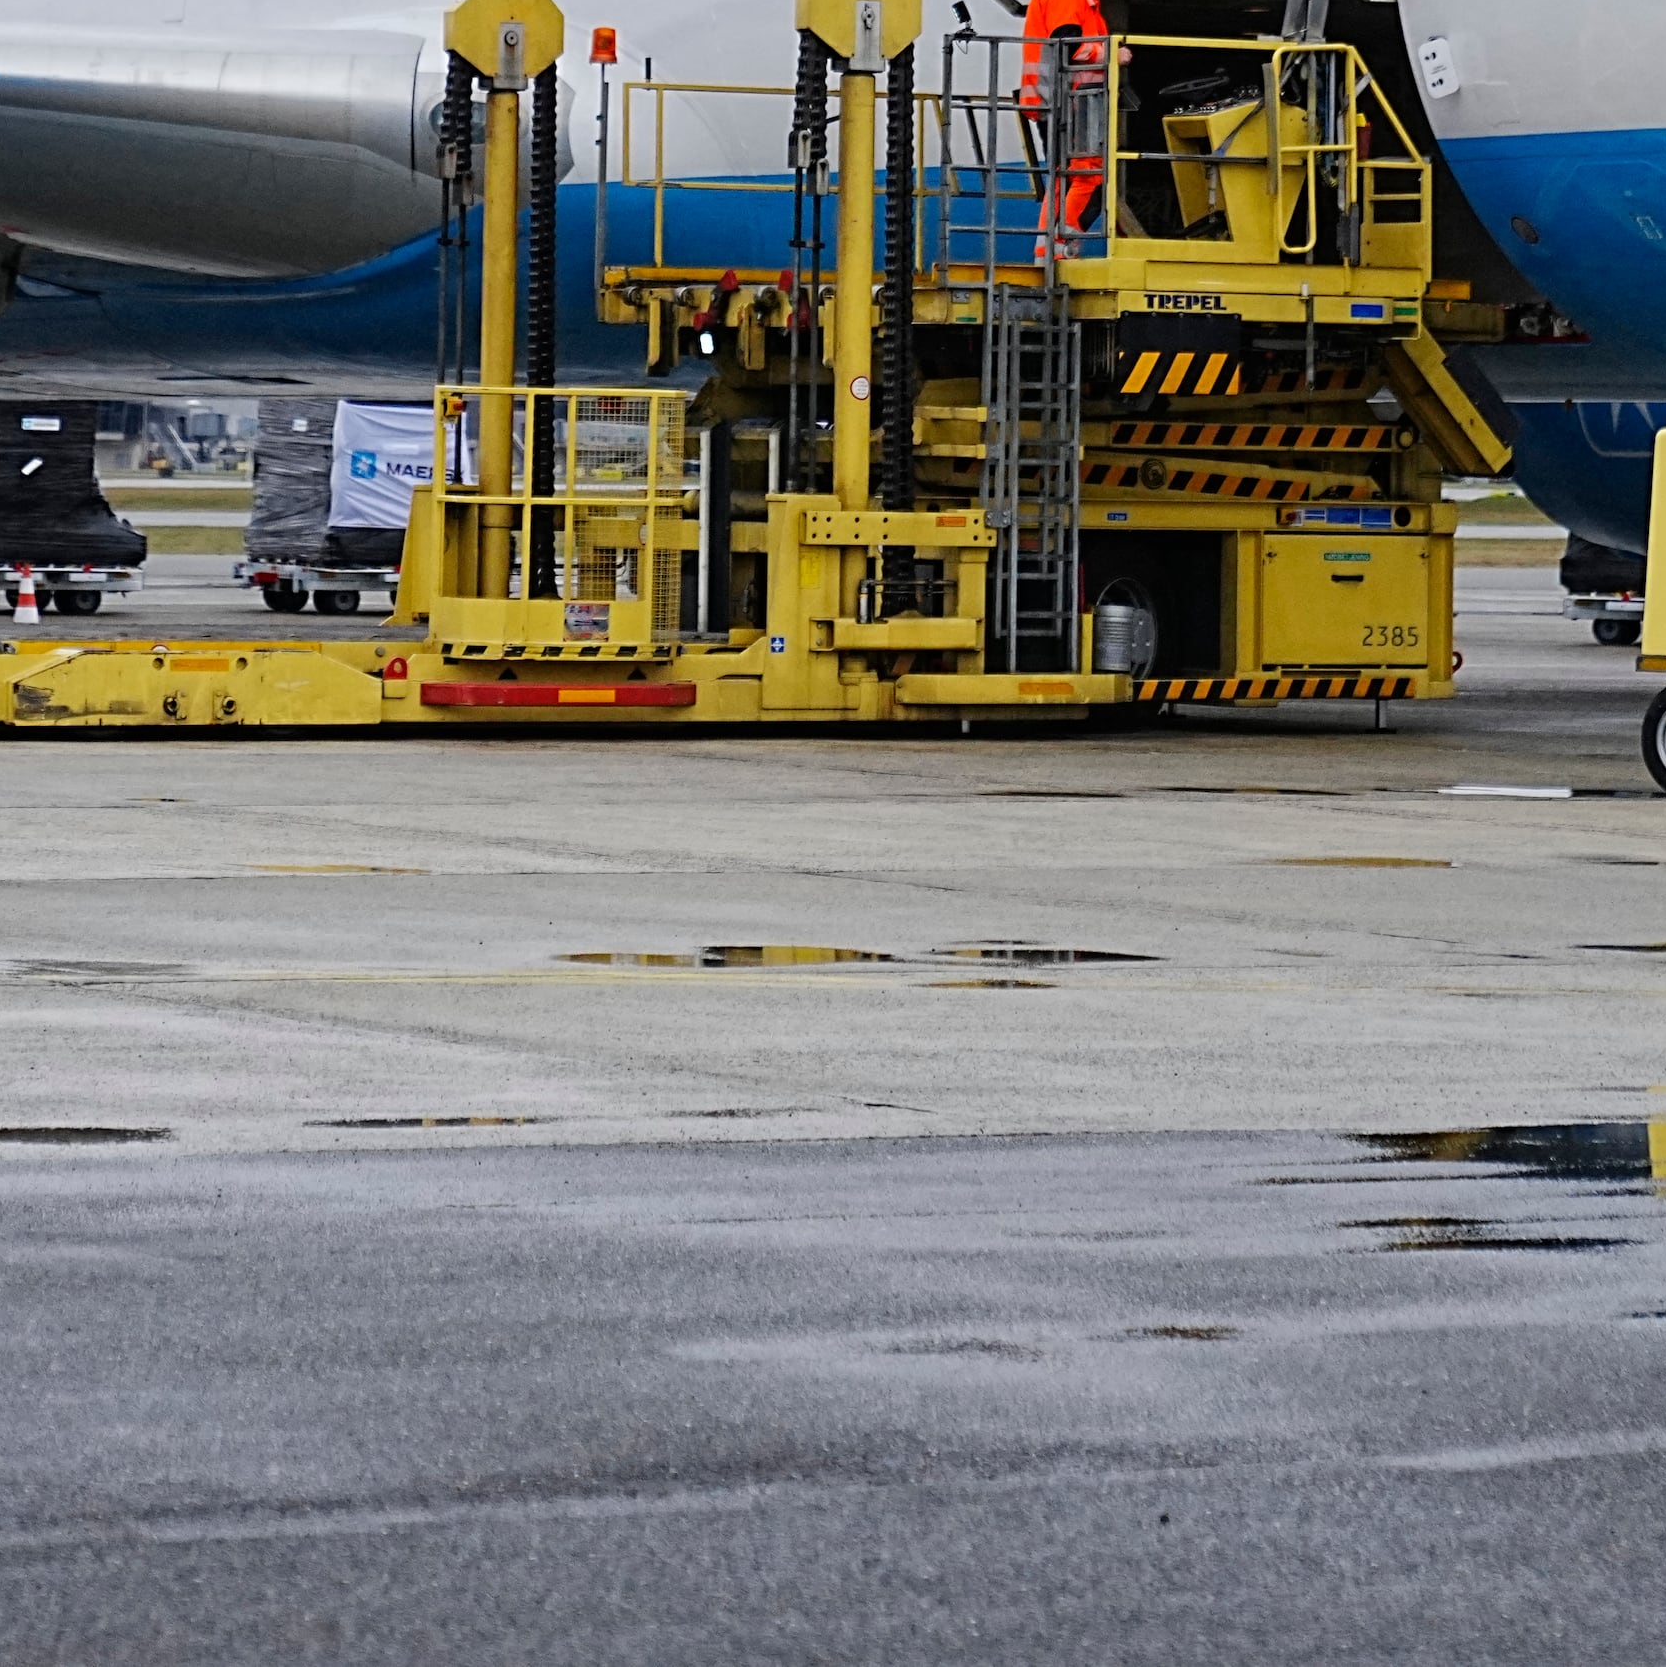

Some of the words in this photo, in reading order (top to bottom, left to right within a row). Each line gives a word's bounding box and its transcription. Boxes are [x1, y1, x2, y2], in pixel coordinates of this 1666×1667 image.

[1144, 294, 1227, 311] TREPEL
[386, 462, 463, 482] MAES
[1362, 625, 1419, 647] 2385
